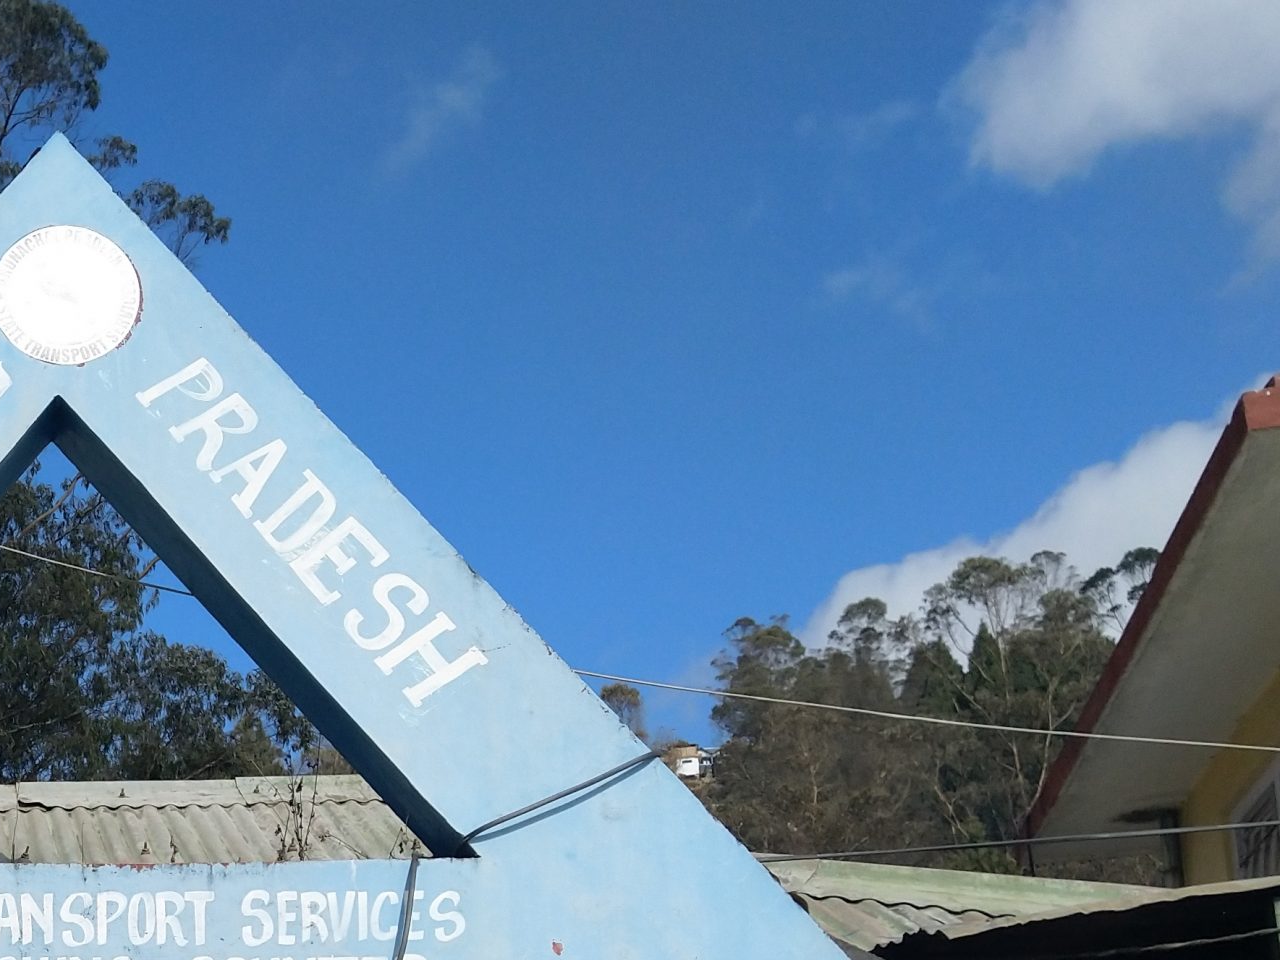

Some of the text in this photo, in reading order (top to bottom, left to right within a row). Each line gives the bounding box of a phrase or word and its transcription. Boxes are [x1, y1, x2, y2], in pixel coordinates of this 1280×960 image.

[24, 335, 109, 365] TRANSPORT
[135, 357, 489, 708] PRADESH
[241, 889, 466, 947] SERVICES
